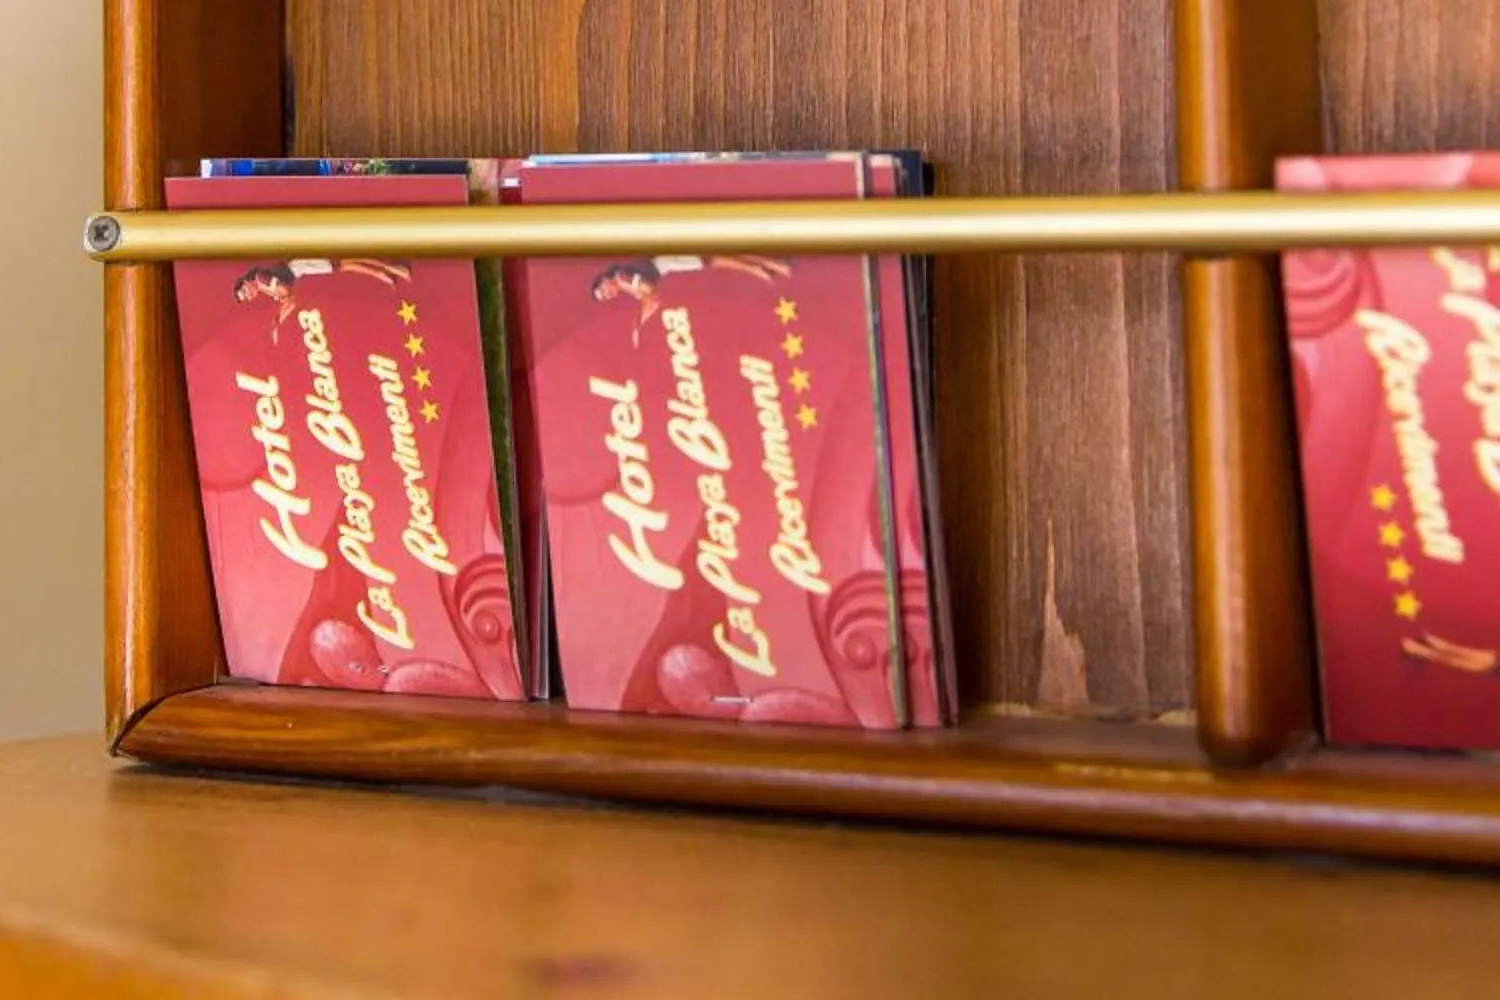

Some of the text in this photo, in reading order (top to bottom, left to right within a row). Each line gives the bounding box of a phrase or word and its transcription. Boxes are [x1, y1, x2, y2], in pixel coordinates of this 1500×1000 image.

[235, 370, 328, 571] Hotel
[297, 308, 414, 651] La Playa Blanca
[367, 353, 458, 577] Ricevimenti
[589, 376, 685, 592] Hotel
[661, 306, 777, 679] La Playa Blanca
[740, 354, 831, 596] Ricevimenti
